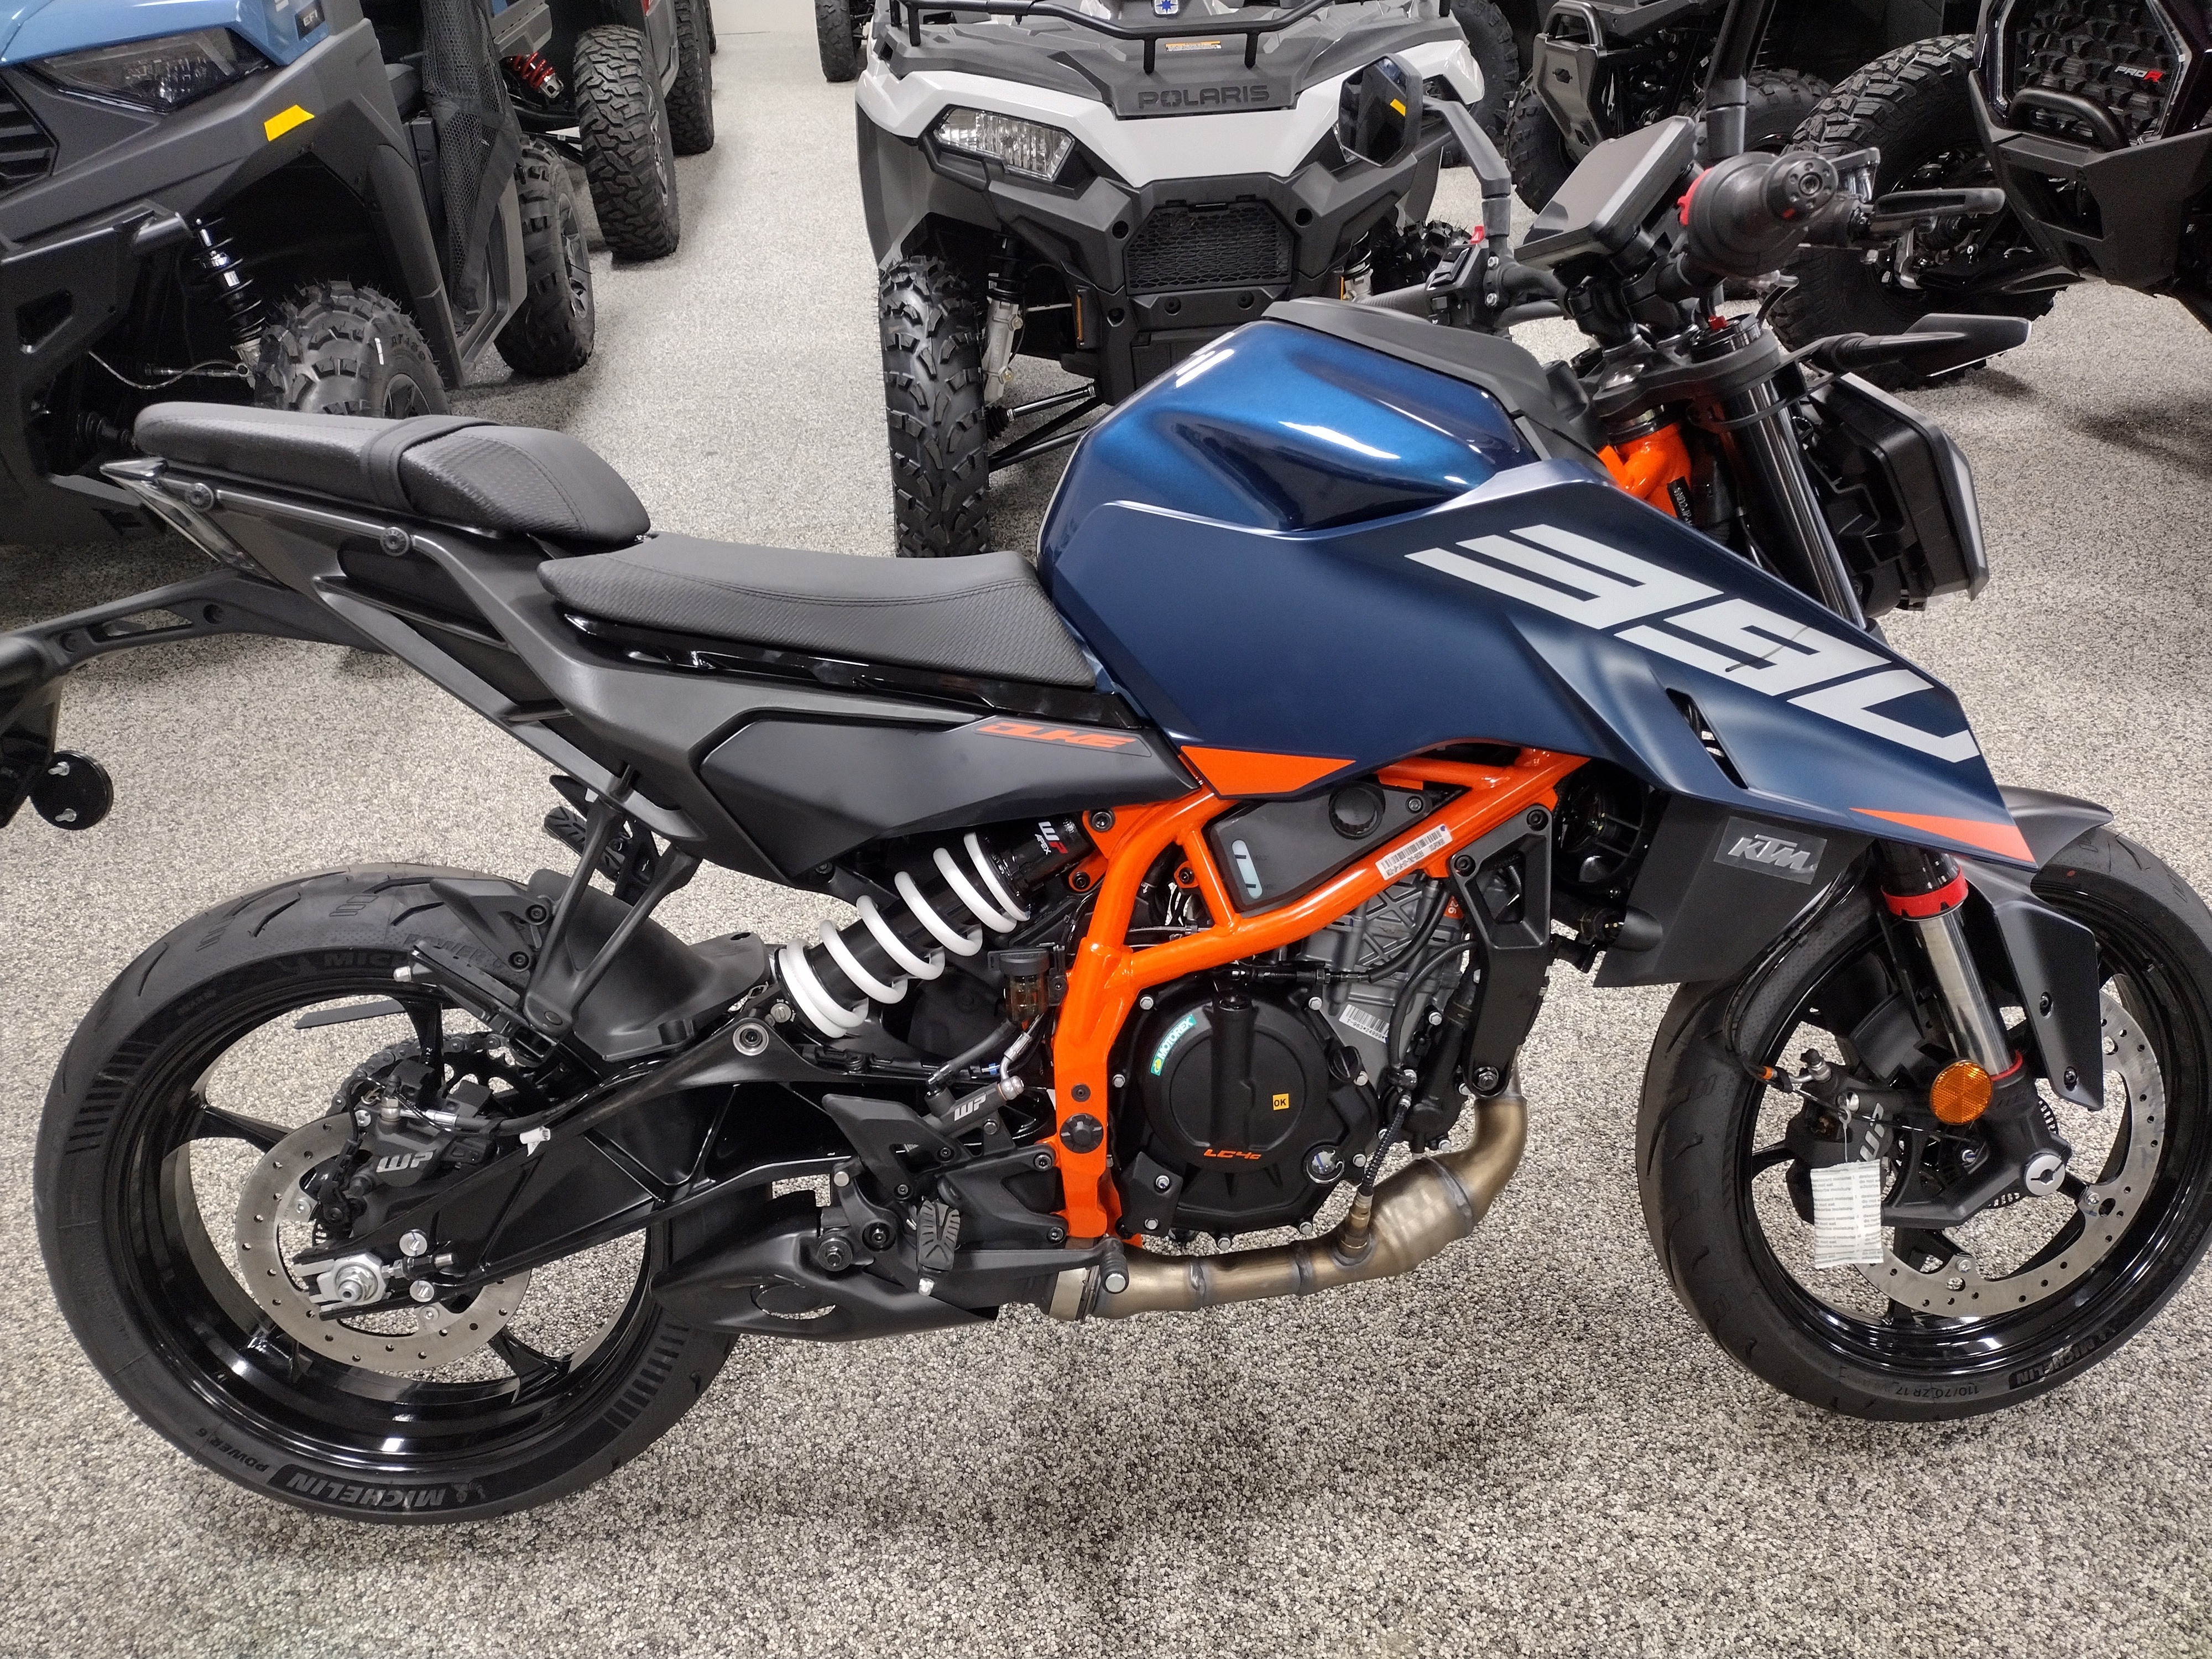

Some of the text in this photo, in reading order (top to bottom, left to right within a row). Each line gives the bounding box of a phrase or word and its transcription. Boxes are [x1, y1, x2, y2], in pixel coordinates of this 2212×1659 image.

[303, 9, 317, 26] EFI
[1138, 85, 1270, 109] POLARIS
[977, 722, 1135, 748] DUKE
[1035, 834, 1051, 855] APEX
[1039, 822, 1068, 853] WP
[1728, 834, 1811, 870] KTM
[1448, 901, 1458, 914] 26
[1157, 1016, 1194, 1060] MOTOREX
[954, 1092, 986, 1121] WP
[376, 1151, 434, 1172] WP
[2016, 1338, 2095, 1384] MICHELIN
[1896, 1385, 1910, 1396] 17
[1914, 1386, 1935, 1397] ZR
[210, 1438, 269, 1472] POWER
[287, 1473, 446, 1507] MICHELIN
